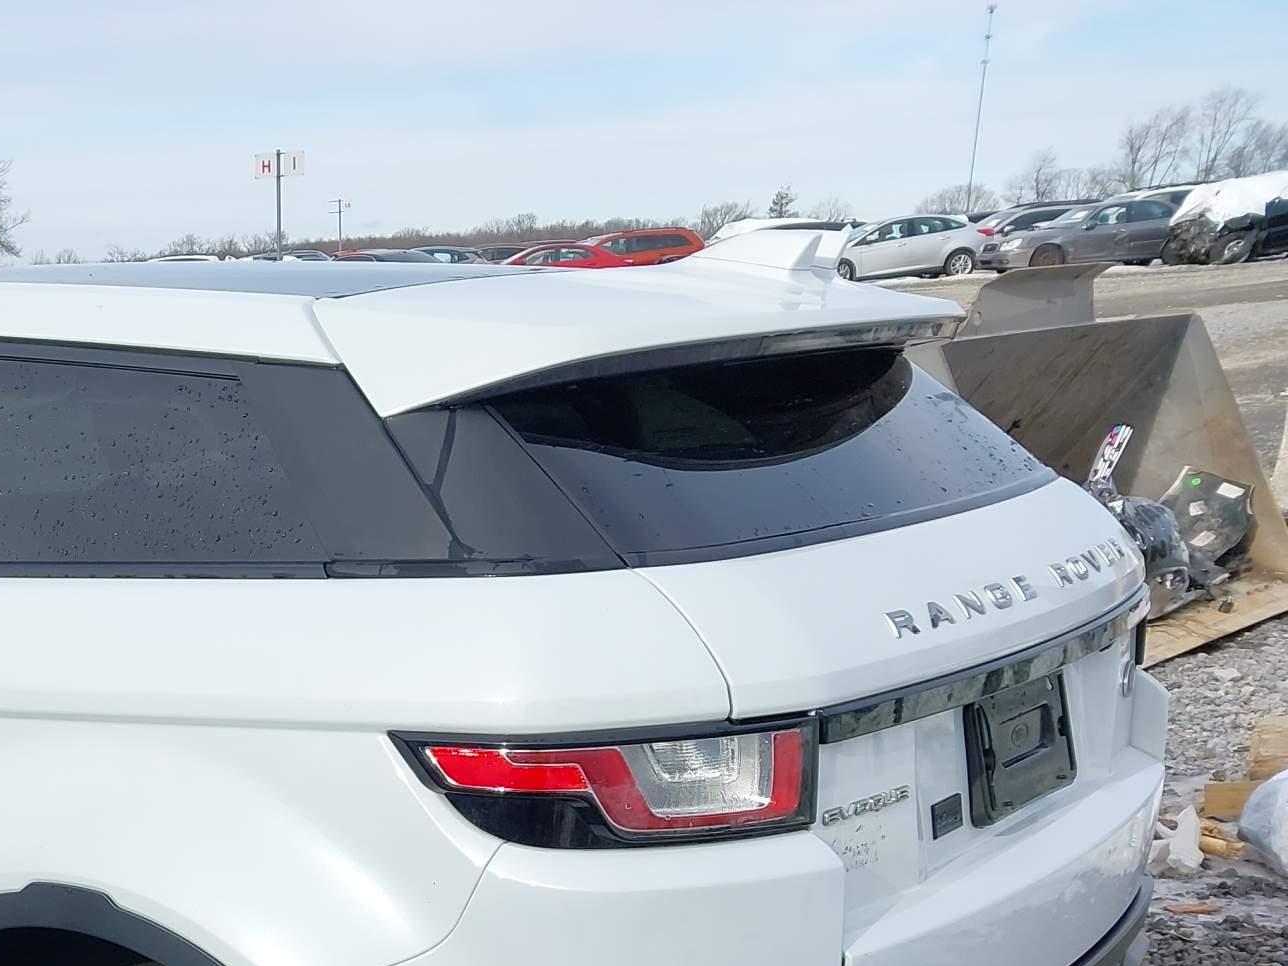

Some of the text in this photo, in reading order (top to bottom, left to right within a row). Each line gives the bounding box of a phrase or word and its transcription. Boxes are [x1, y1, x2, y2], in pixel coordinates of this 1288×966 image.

[261, 159, 271, 174] H
[882, 537, 1125, 639] RANGE ROVER
[822, 784, 911, 827] EVOQUE
